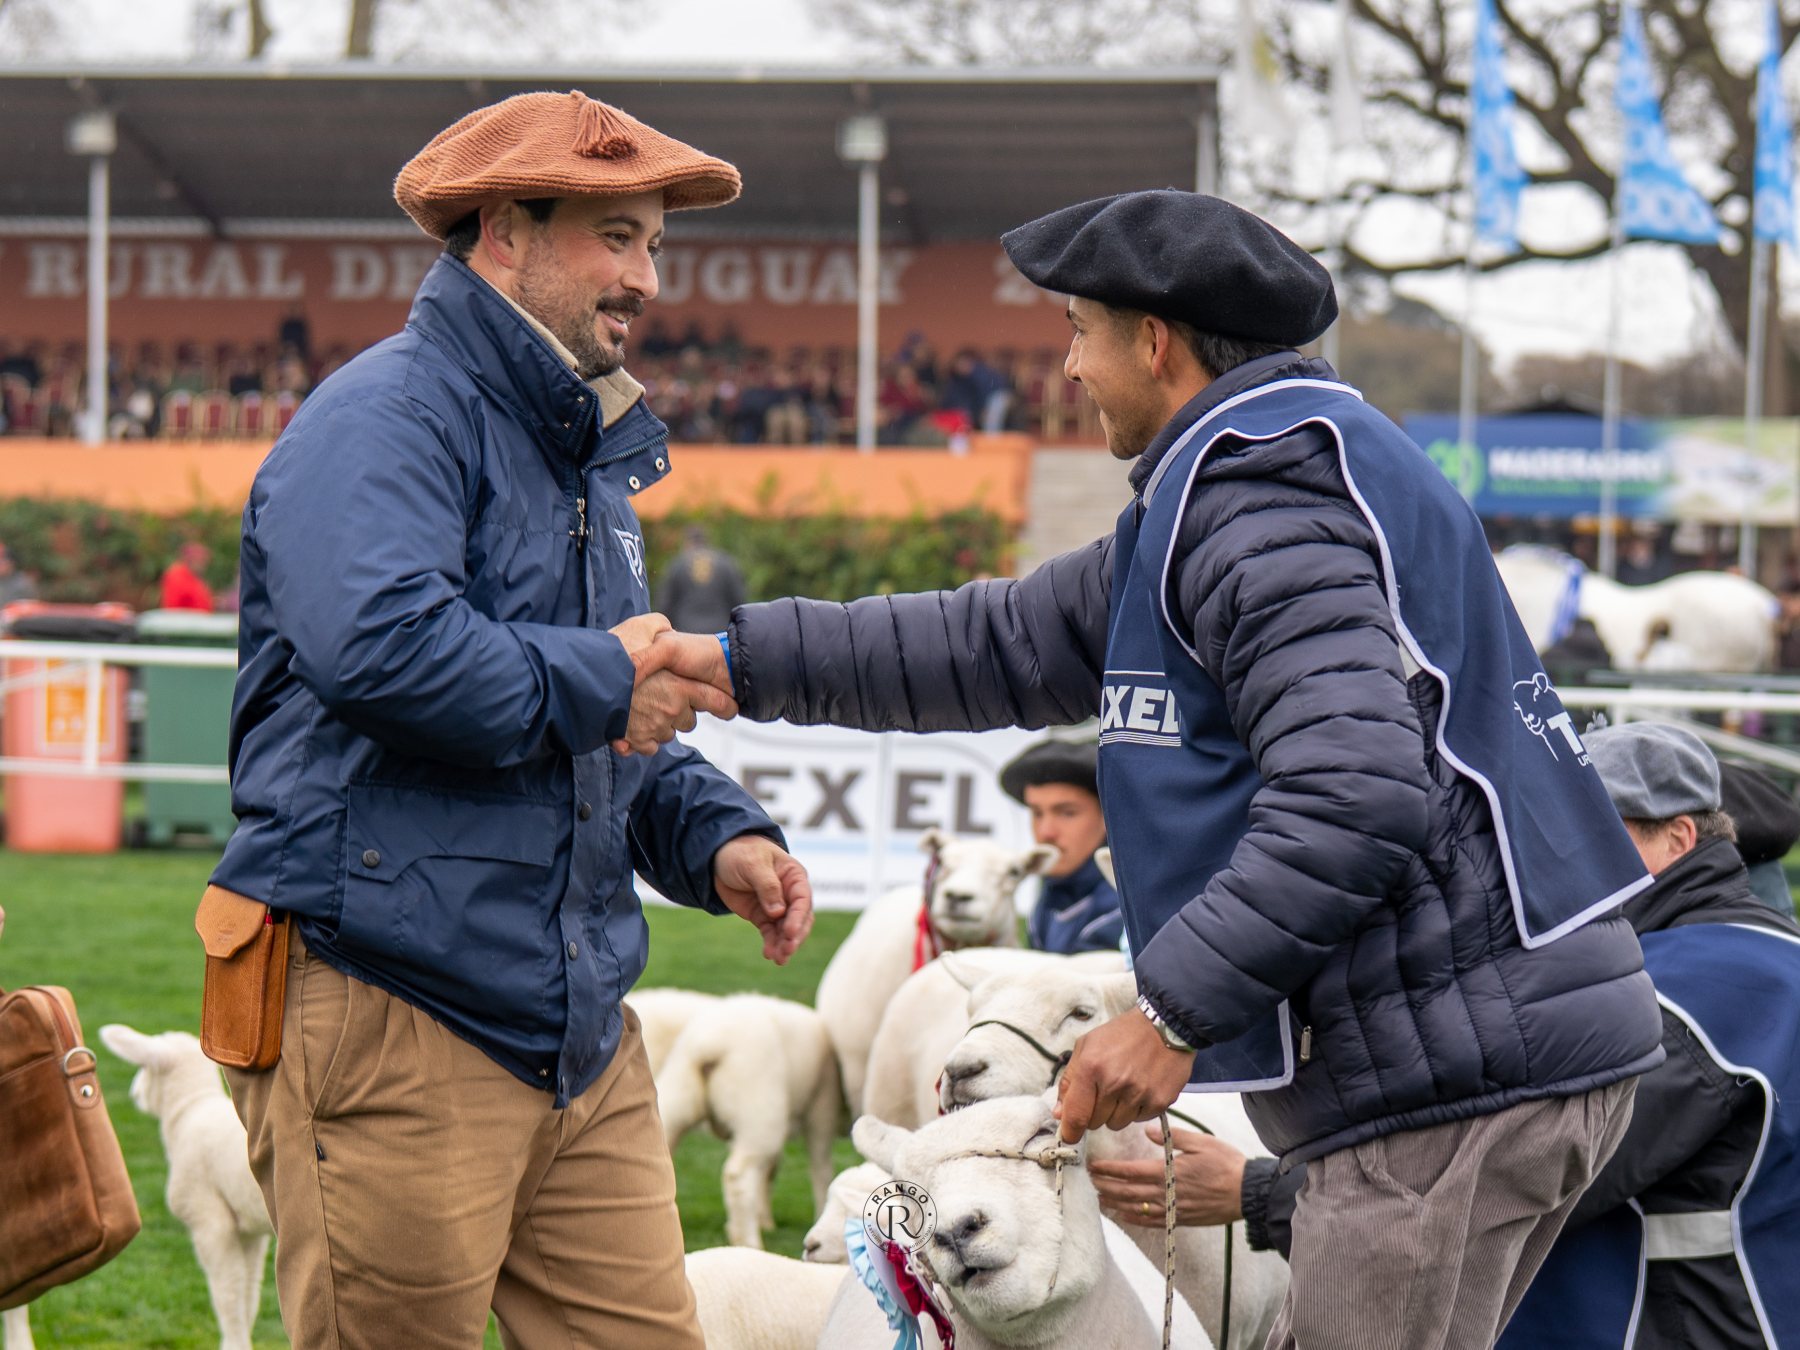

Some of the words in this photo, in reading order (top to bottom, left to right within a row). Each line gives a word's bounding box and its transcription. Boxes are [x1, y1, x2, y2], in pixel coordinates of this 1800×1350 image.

[25, 242, 304, 298] RURAL
[331, 243, 440, 300] DE
[655, 248, 914, 303] UGUAY
[1101, 685, 1180, 733] XEL
[740, 765, 995, 834] EXEL
